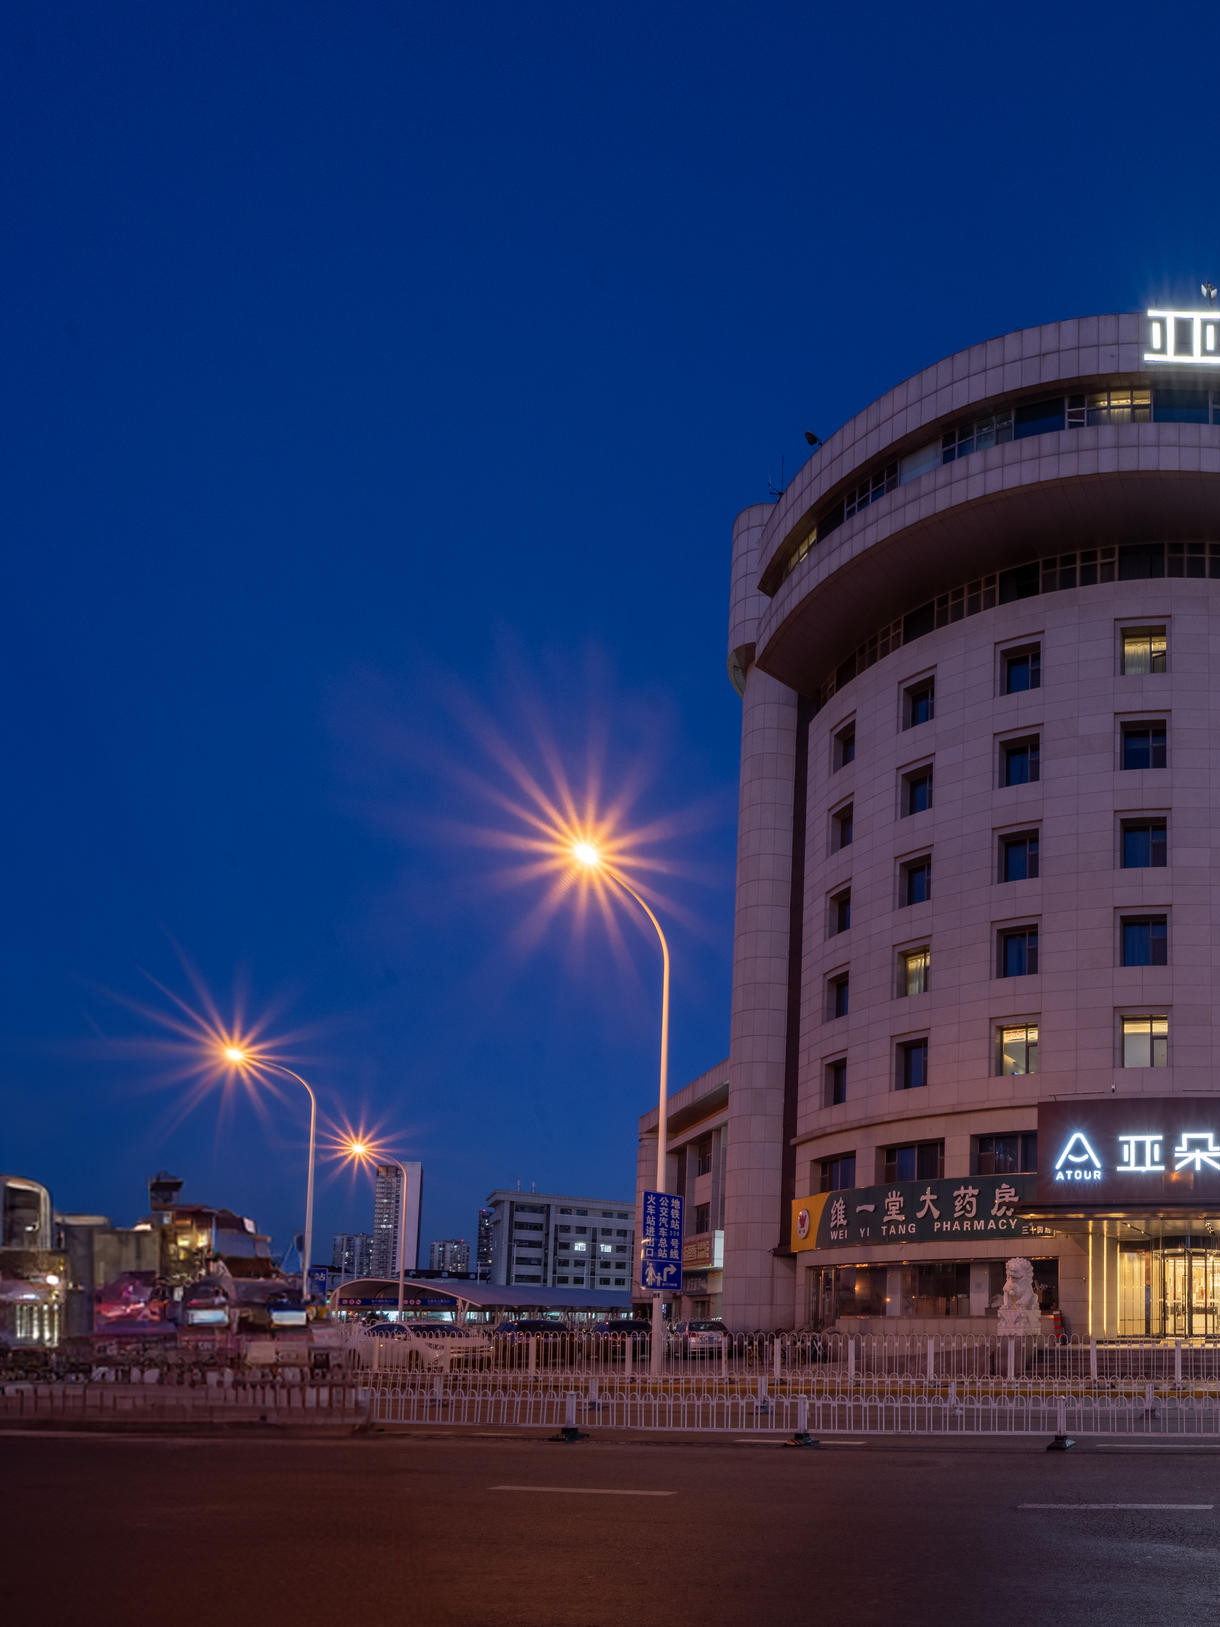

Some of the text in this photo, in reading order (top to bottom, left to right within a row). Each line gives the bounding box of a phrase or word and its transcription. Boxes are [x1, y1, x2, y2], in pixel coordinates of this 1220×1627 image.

[1055, 1170, 1102, 1181] ATOUR
[645, 1194, 656, 1257] 火车站进出口
[658, 1196, 669, 1258] 公交汽车总站
[830, 1184, 1019, 1228] 维一堂大药房
[830, 1218, 1019, 1241] WEI YI TANG PHARMACY
